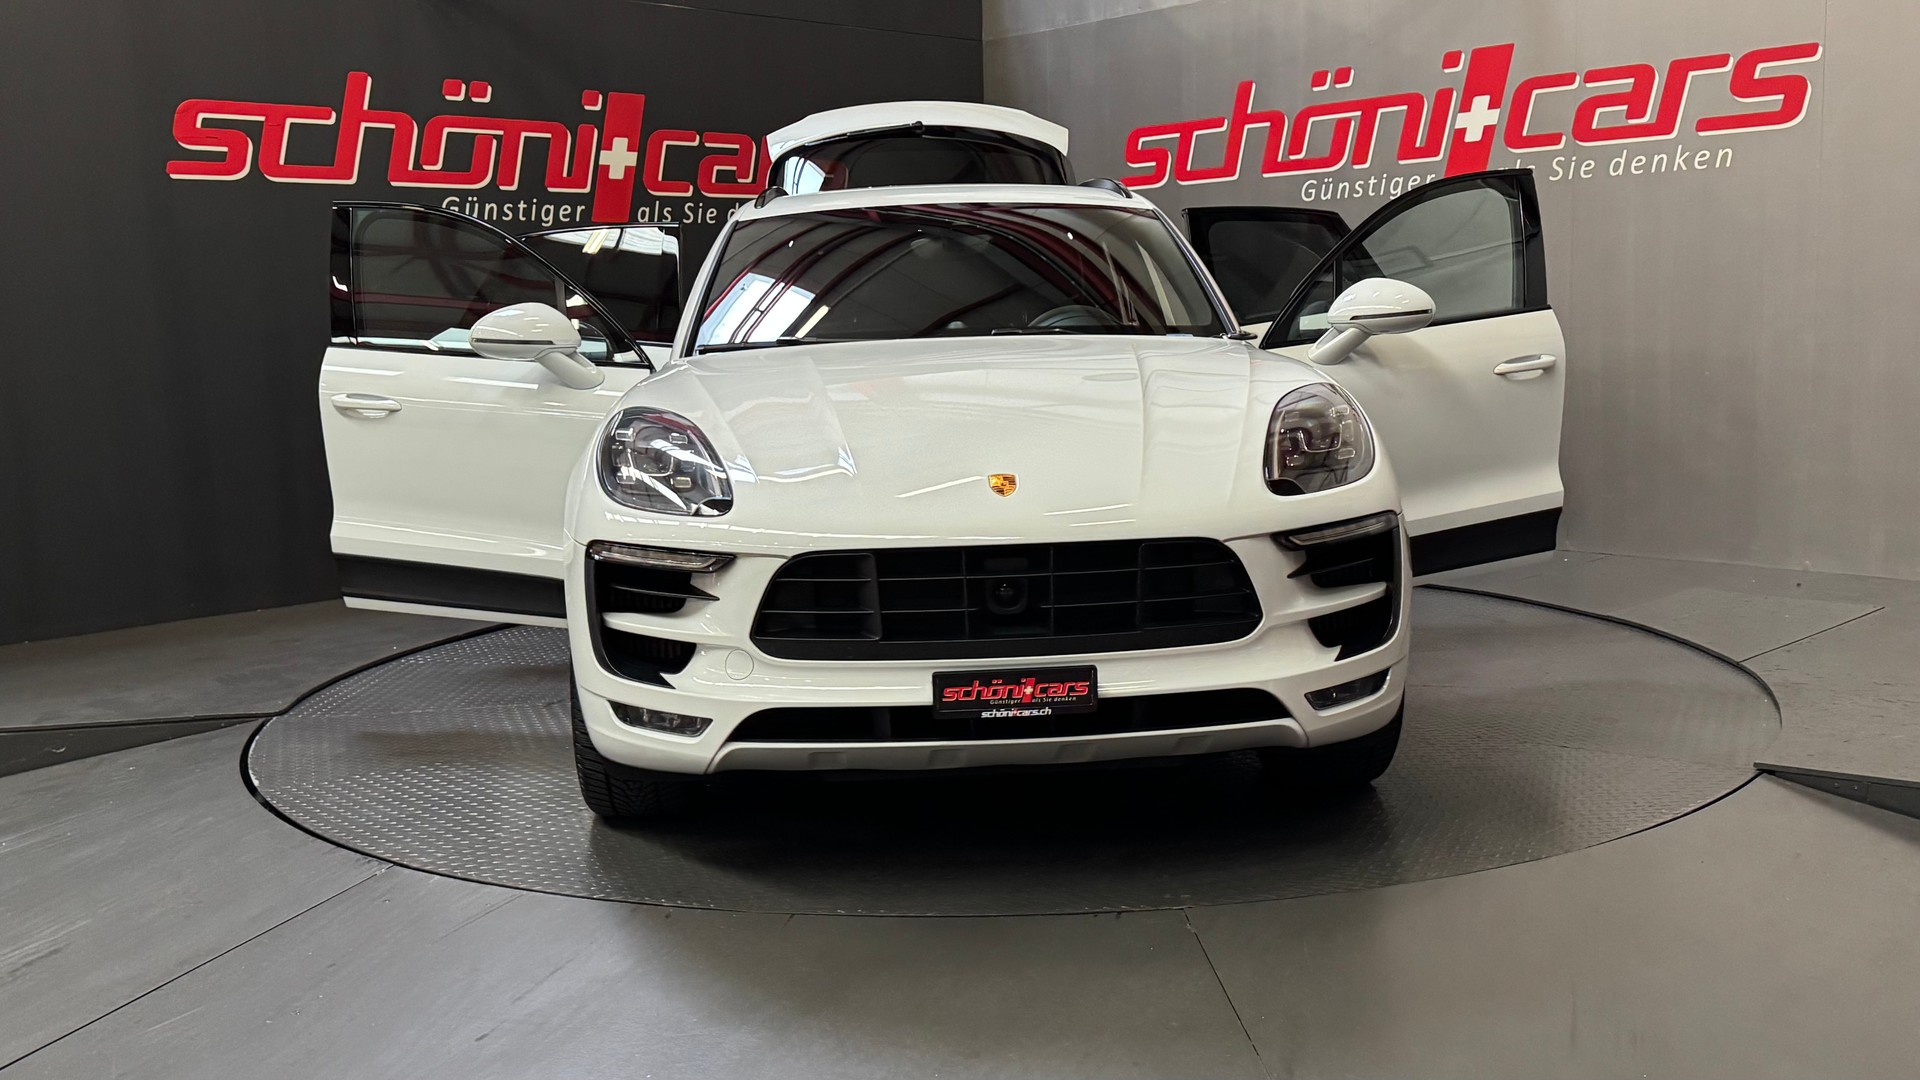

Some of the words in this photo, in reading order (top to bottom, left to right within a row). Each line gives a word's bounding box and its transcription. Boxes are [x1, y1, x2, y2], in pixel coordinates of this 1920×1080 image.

[1301, 173, 1436, 202] Günstiger
[1549, 155, 1596, 181] Sie
[1608, 144, 1733, 177] denken
[637, 200, 672, 223] als
[682, 202, 718, 224] Sie
